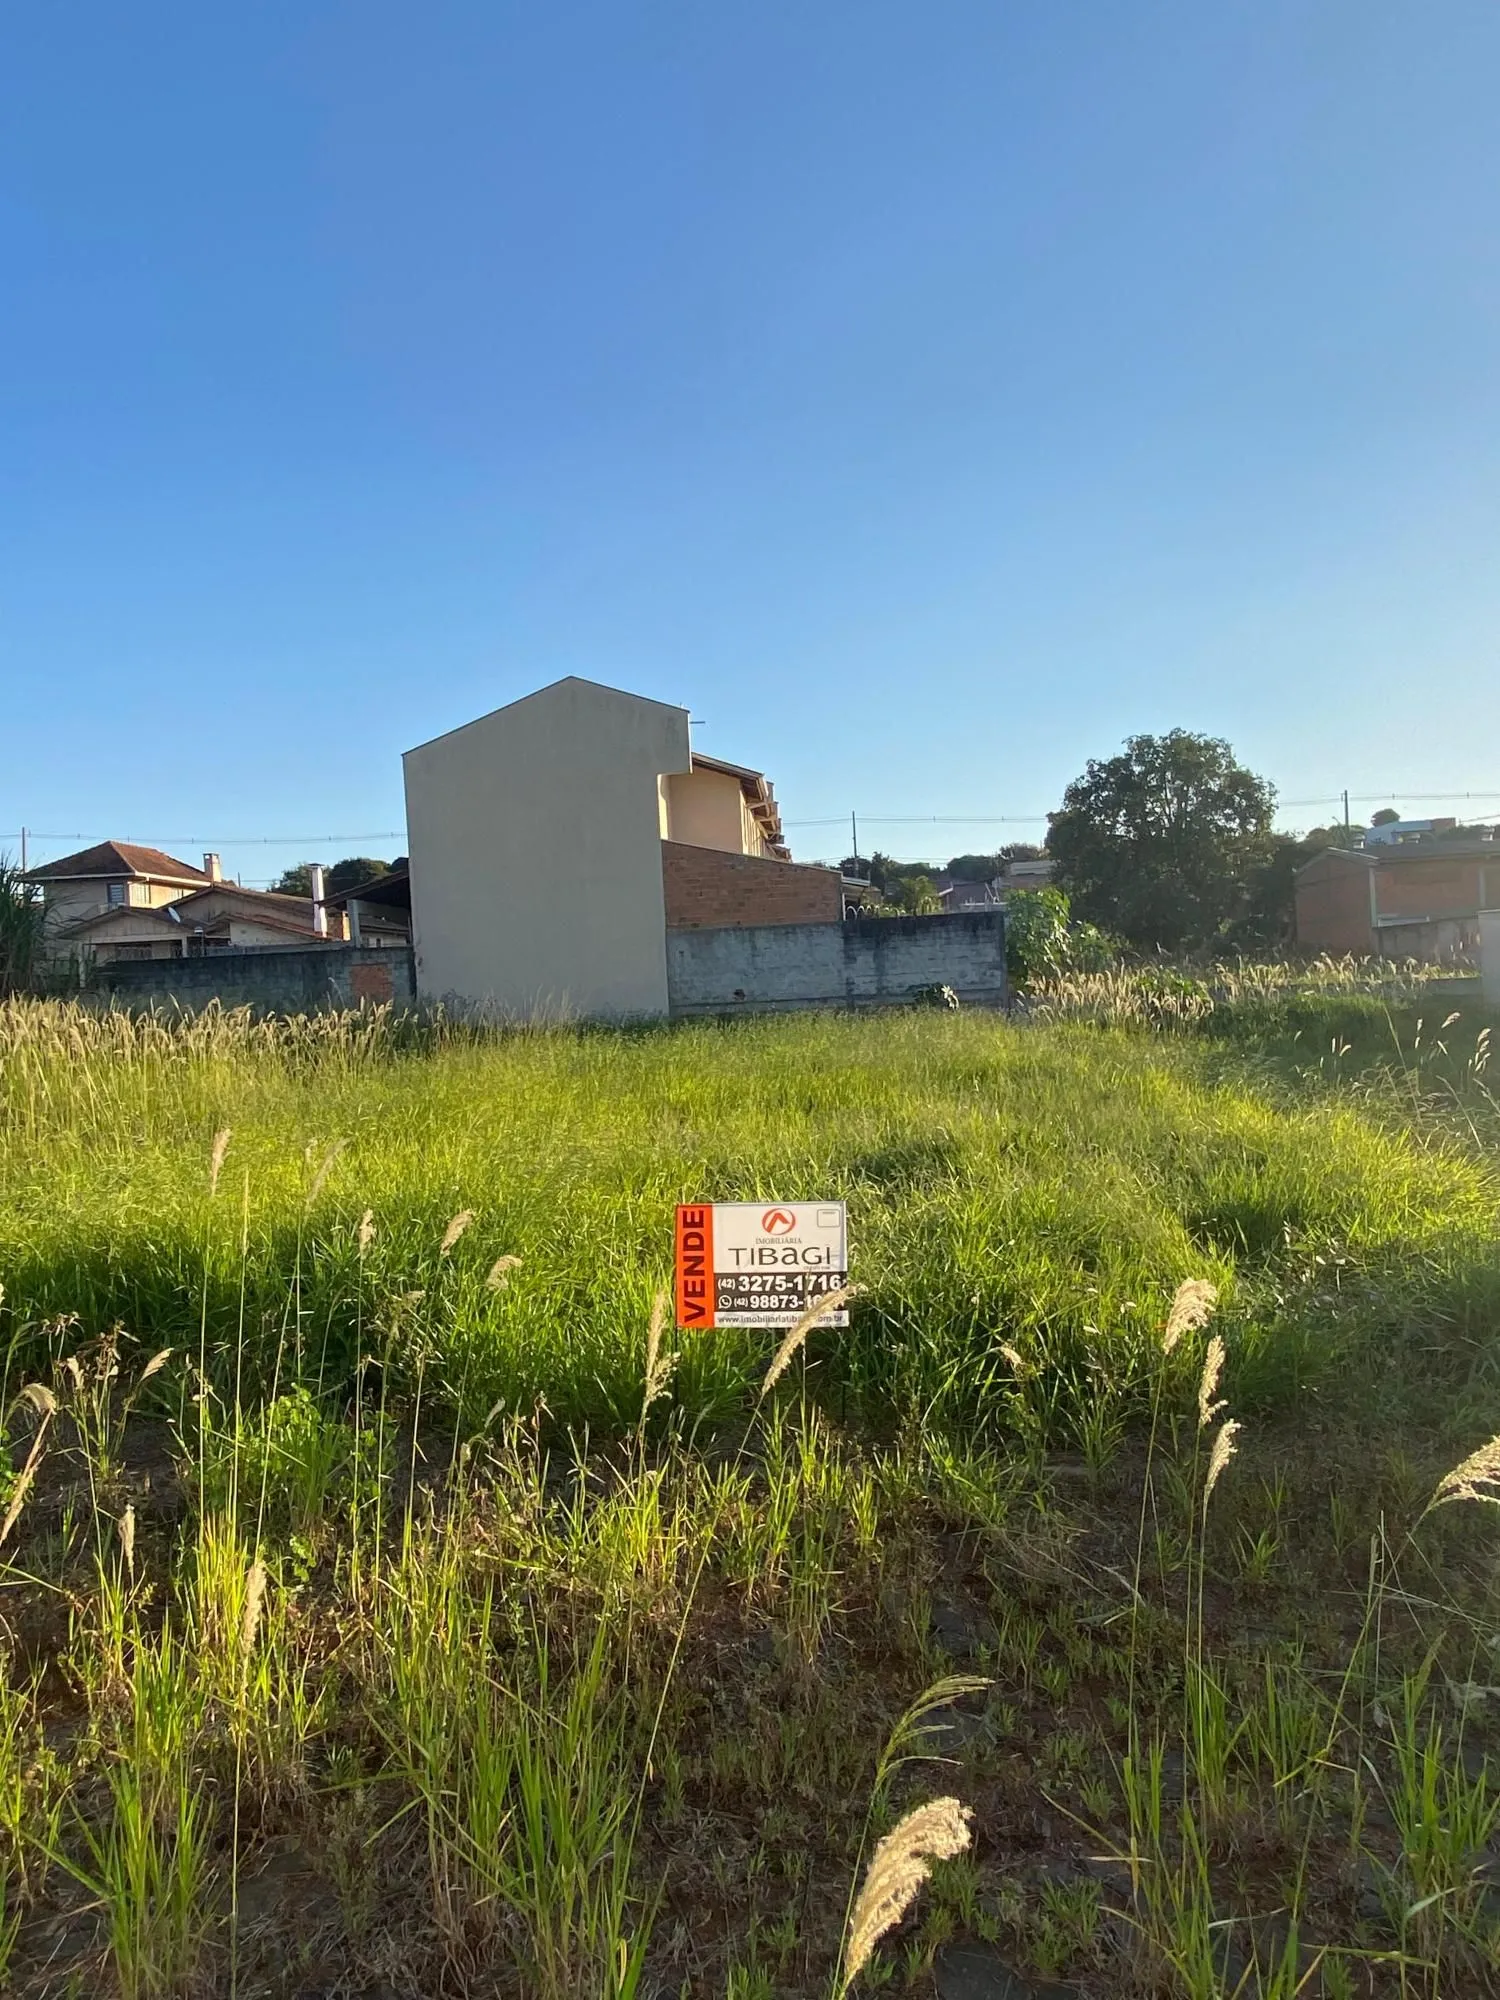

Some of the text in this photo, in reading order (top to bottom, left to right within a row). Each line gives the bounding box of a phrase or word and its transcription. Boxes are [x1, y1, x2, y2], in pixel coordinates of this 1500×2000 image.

[683, 1210, 706, 1323] VENDE
[718, 1274, 842, 1291] (42) 3275-1716
[734, 1297, 748, 1308] (42)
